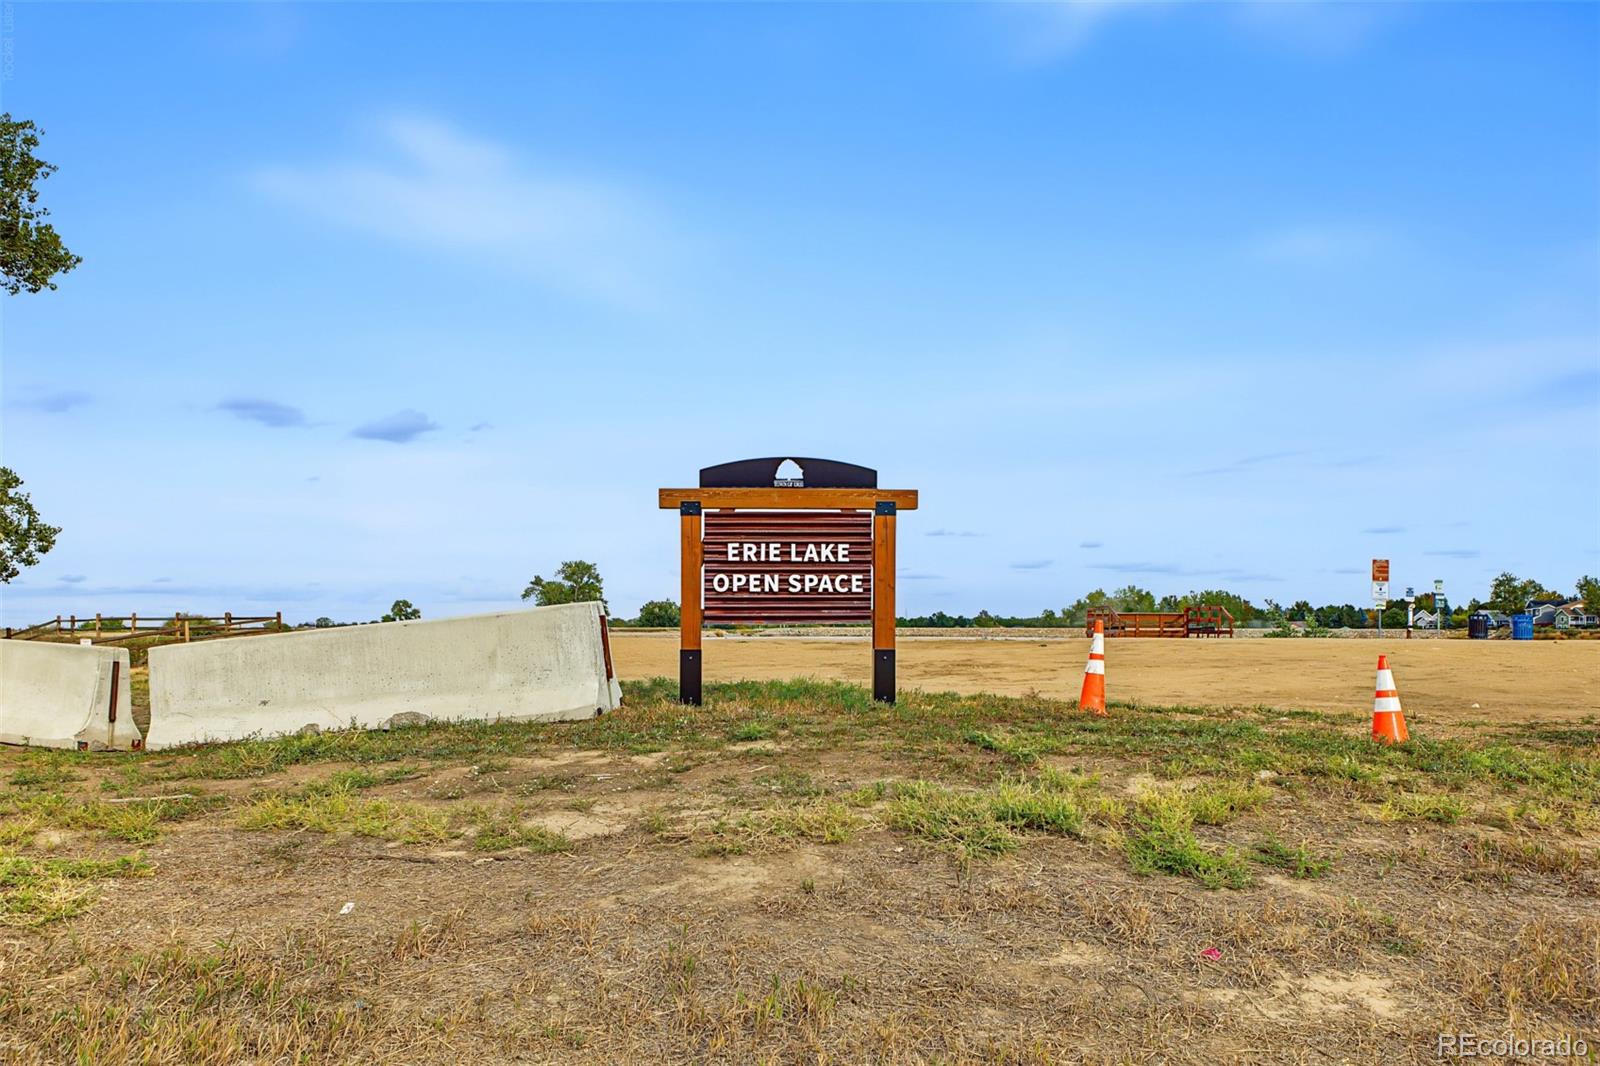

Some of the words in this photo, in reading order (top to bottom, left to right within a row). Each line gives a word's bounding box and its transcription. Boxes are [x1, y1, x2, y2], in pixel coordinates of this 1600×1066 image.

[727, 543, 781, 562] ERIE
[790, 543, 850, 562] LAKE
[713, 574, 779, 593] OPEN
[788, 574, 864, 593] SPACE
